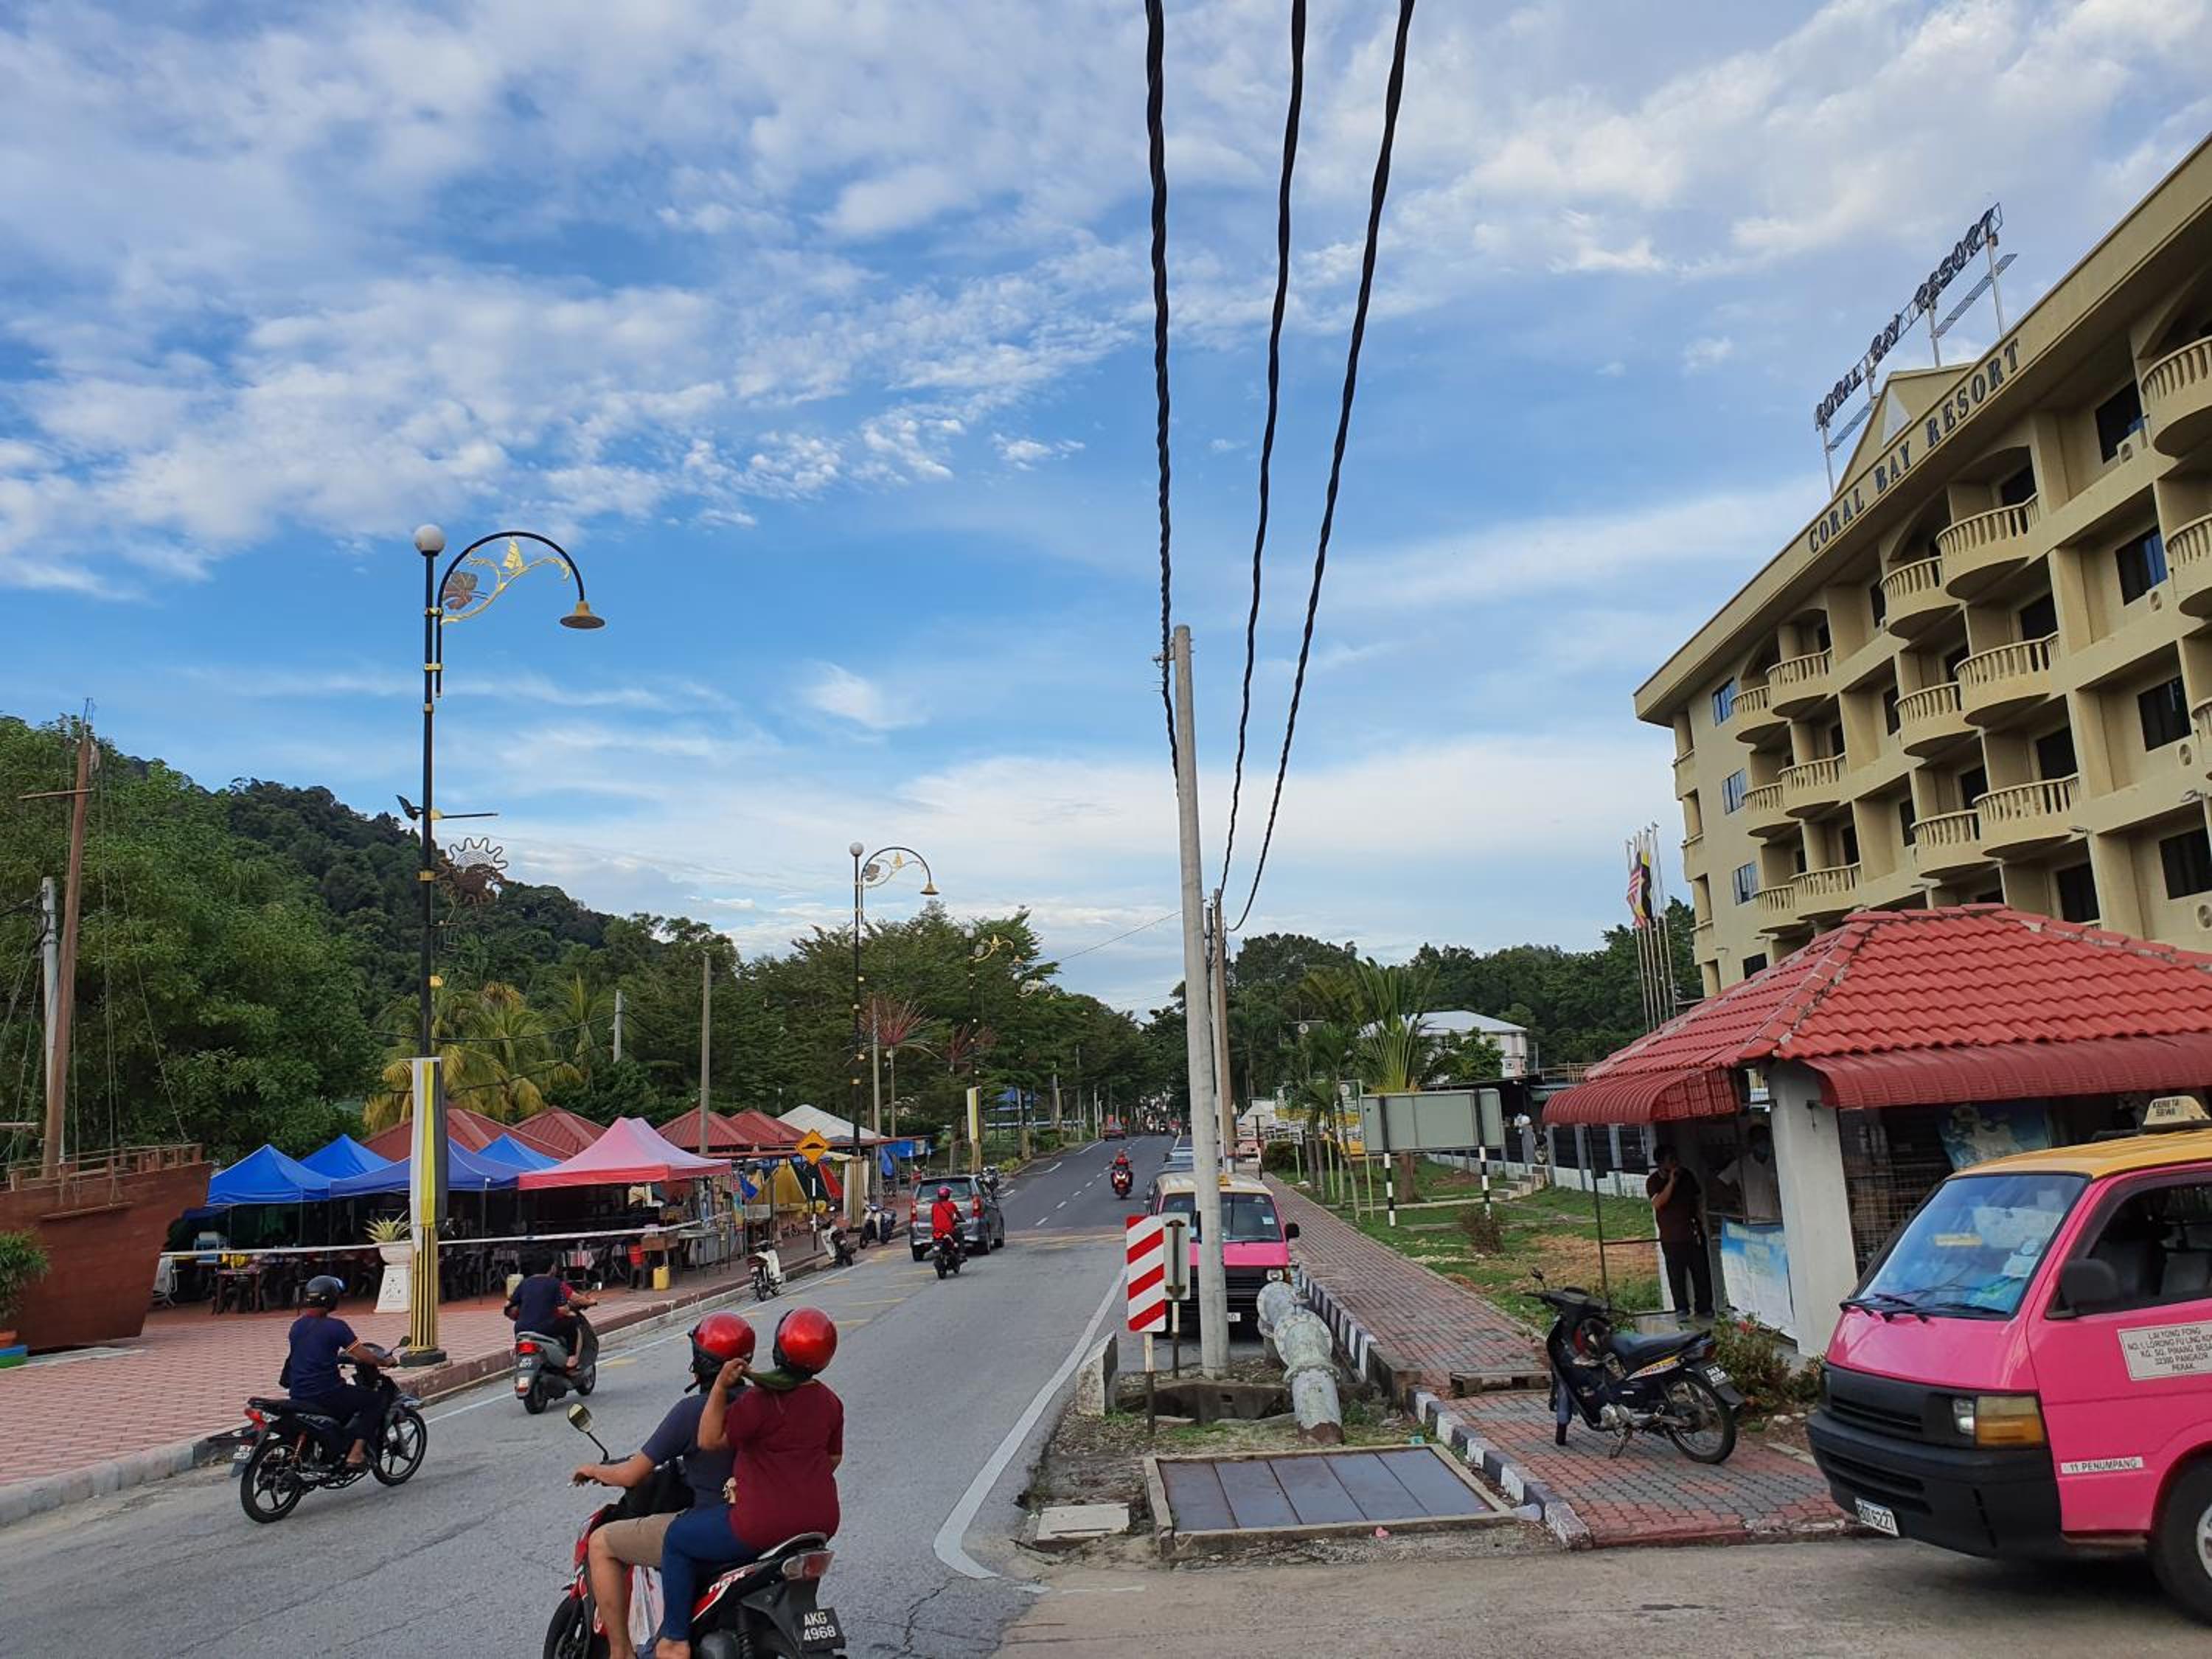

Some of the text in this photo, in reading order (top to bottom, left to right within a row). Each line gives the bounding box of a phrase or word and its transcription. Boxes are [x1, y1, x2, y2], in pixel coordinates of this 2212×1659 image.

[1870, 313, 1901, 363] BAY
[1808, 338, 2021, 554] CORAL BAY RESORT
[2081, 1458, 2138, 1470] PENUMPANG
[804, 1611, 827, 1627] AKG
[803, 1624, 837, 1641] 4968
